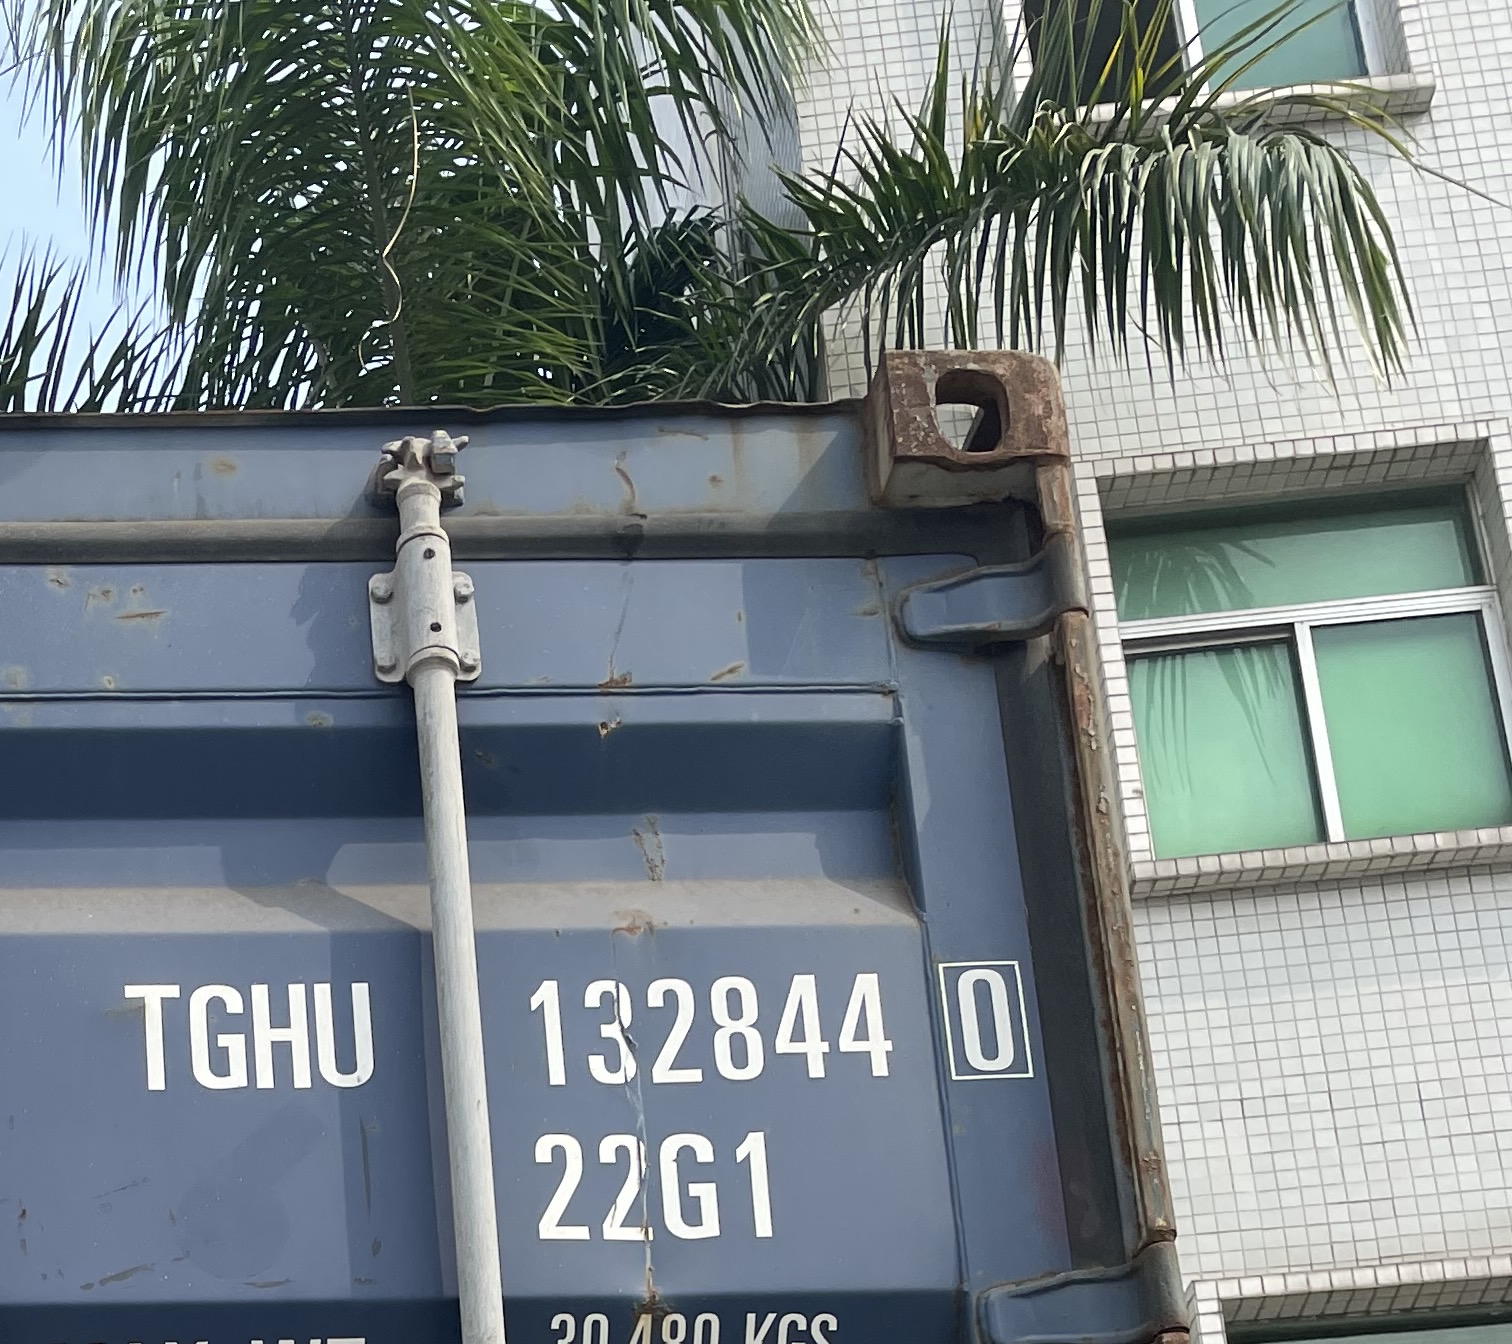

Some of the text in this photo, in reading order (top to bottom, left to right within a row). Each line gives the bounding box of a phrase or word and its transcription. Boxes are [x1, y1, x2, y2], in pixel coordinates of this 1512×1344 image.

[124, 968, 1015, 1091] TGHU 132844 0
[534, 1131, 775, 1240] 22G1
